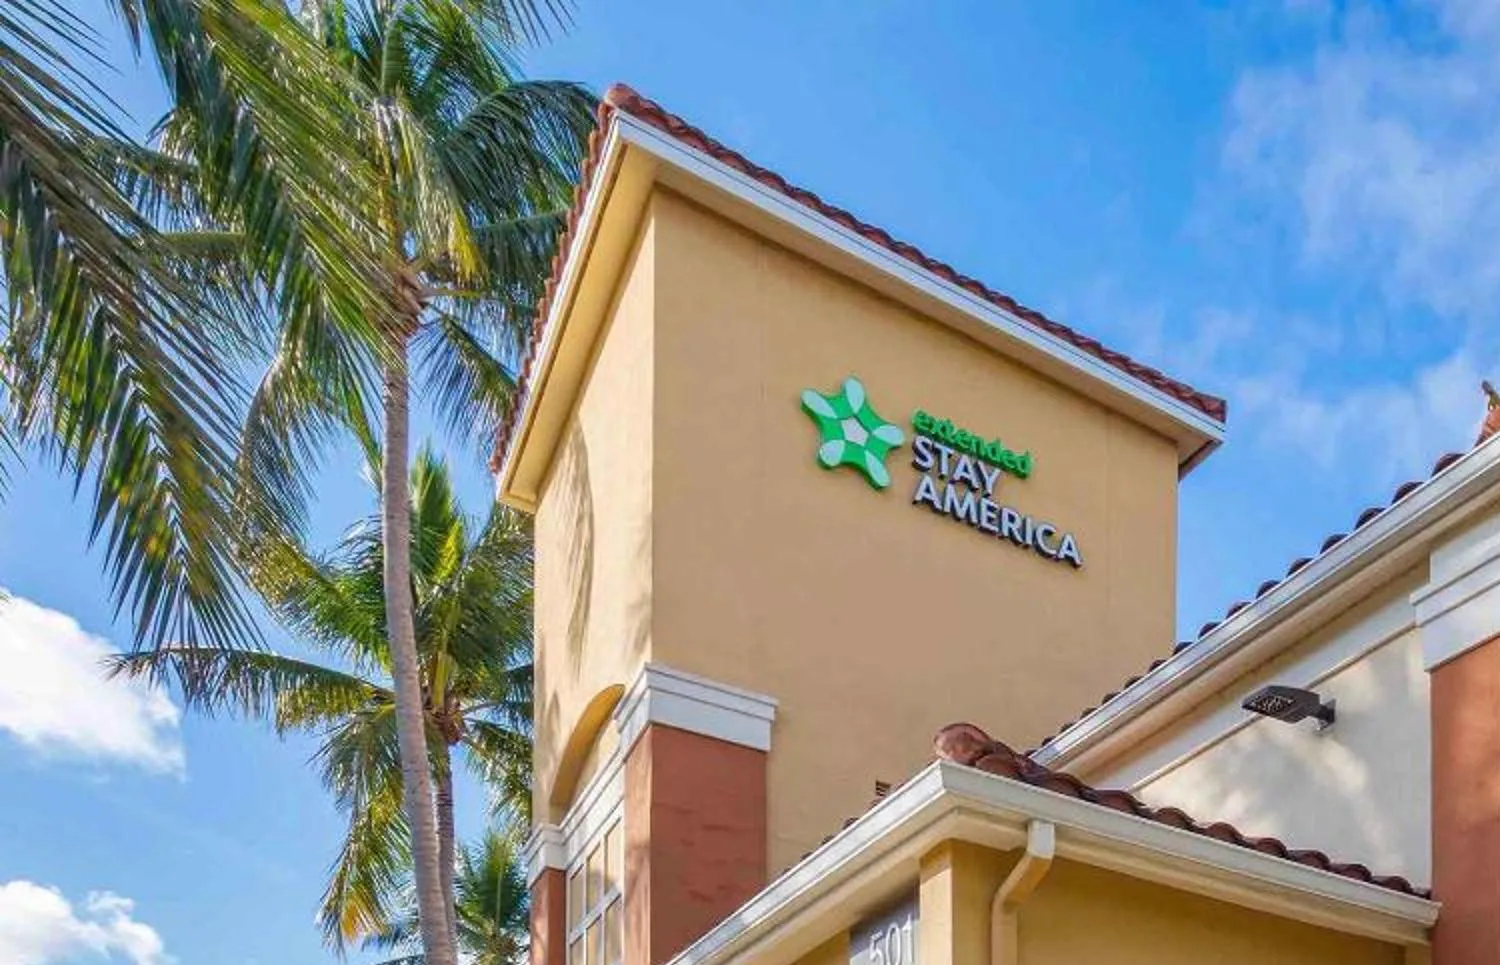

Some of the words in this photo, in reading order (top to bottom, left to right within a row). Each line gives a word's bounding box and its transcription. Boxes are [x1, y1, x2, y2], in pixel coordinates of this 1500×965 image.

[911, 408, 1034, 479] extended
[912, 435, 1001, 495] STAY
[912, 475, 1082, 568] AMERICA
